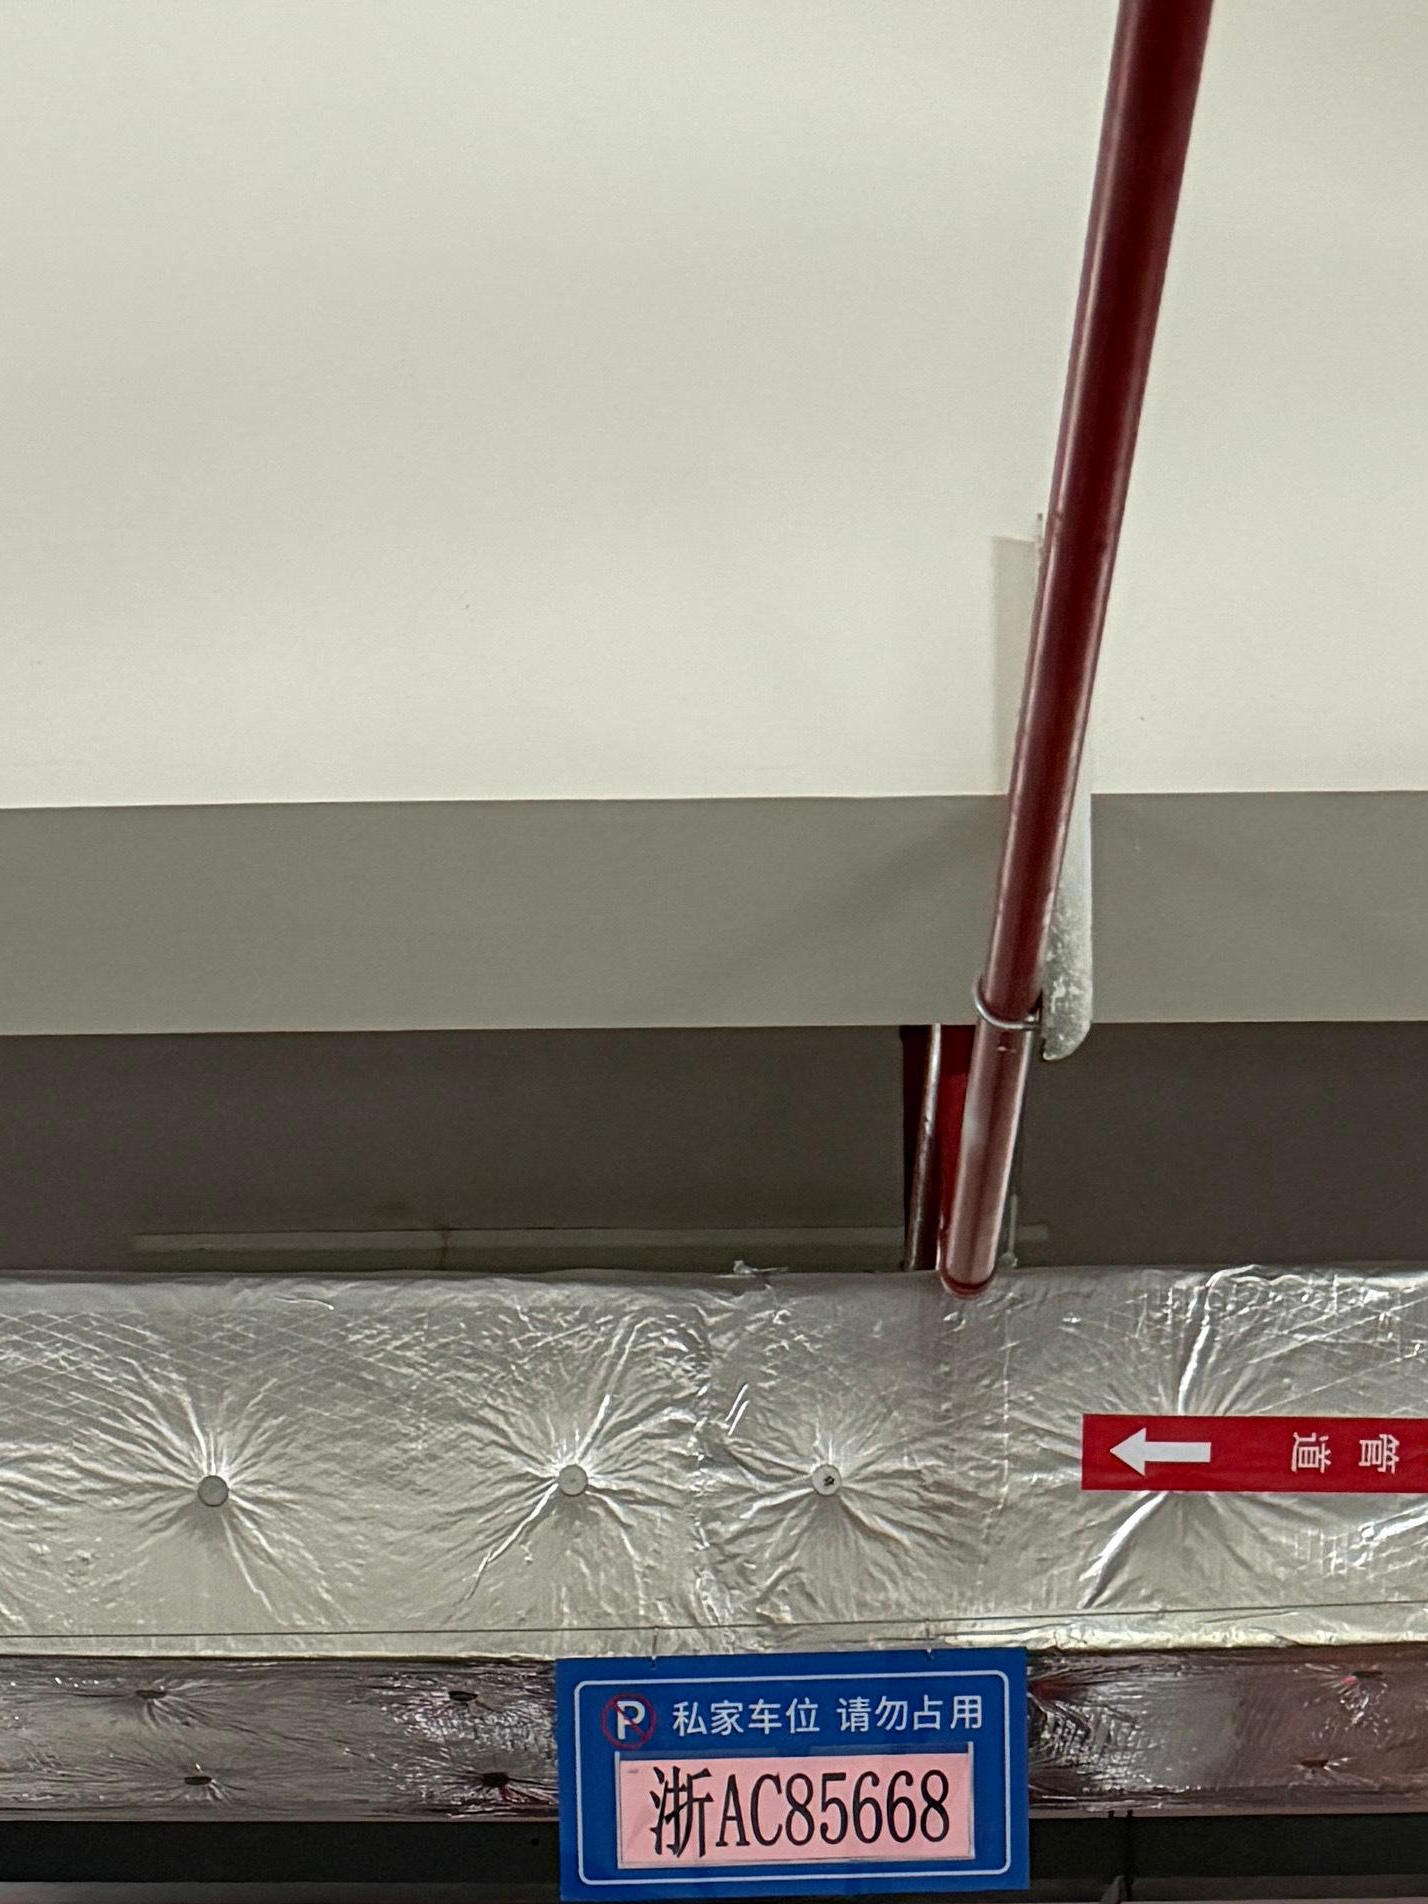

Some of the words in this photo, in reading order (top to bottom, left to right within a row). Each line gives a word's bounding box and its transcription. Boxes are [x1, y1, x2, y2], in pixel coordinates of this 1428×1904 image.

[672, 1697, 821, 1737] 私家车位
[837, 1694, 983, 1732] 请勿占用
[650, 1765, 951, 1858] 浙AC85668
